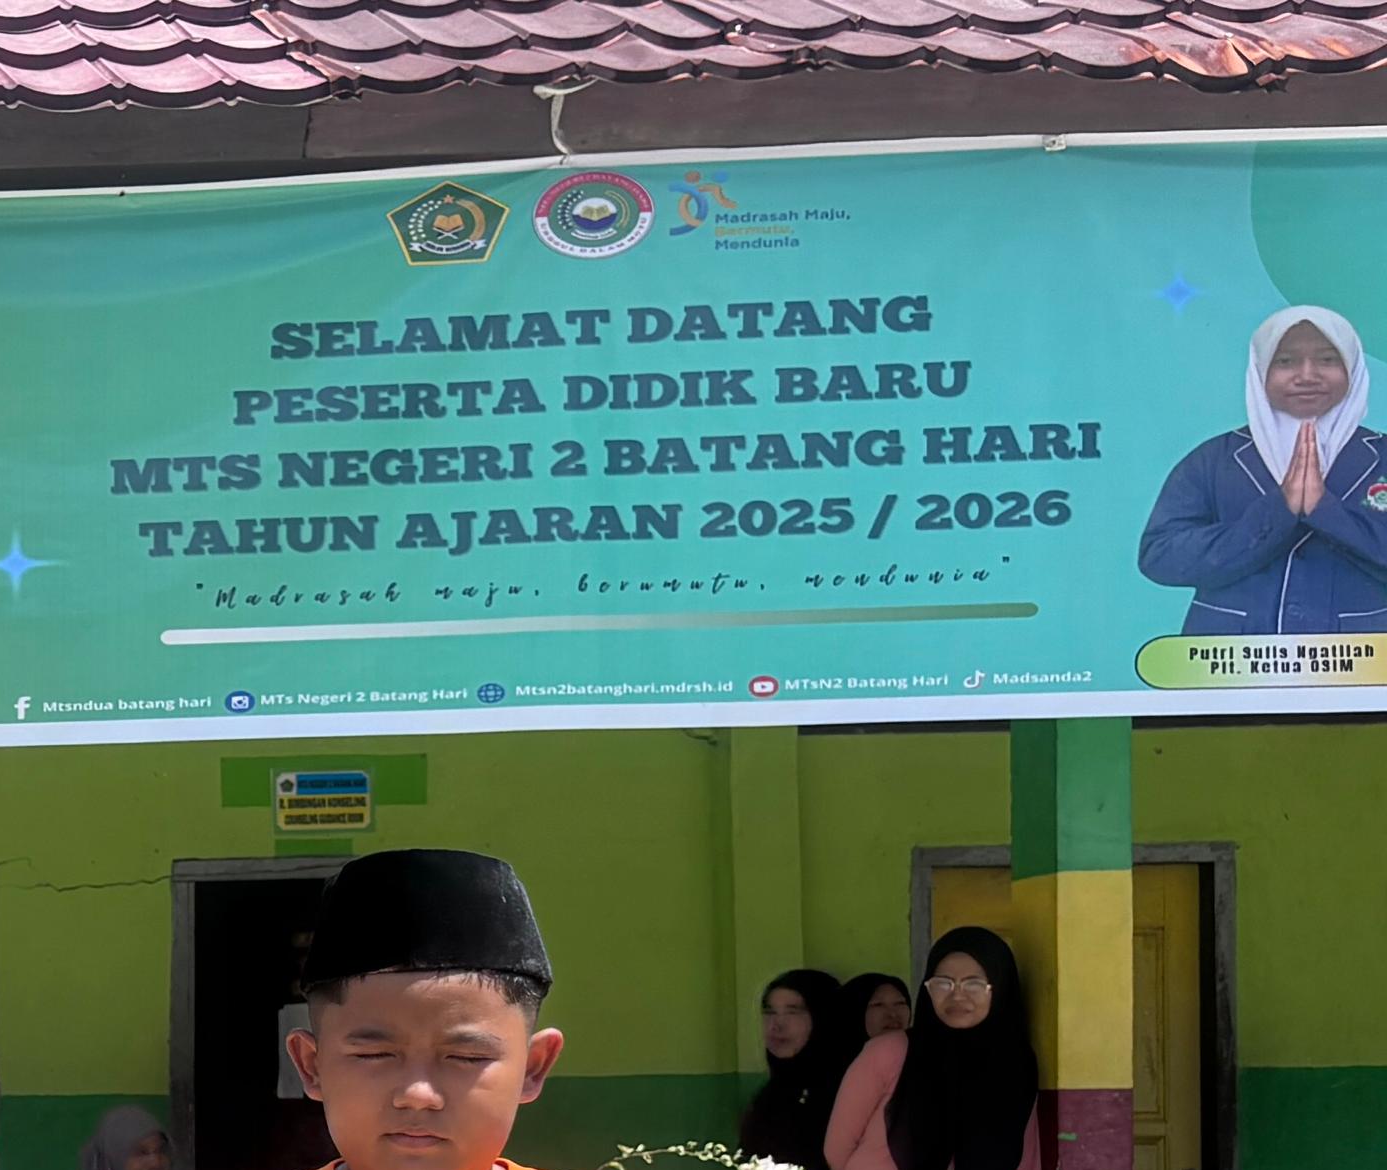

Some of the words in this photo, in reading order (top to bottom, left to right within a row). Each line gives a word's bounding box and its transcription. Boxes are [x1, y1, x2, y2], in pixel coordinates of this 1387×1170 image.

[715, 210, 799, 224] Madrasah
[804, 208, 851, 221] Maju,
[714, 236, 800, 250] Mendunia
[270, 308, 610, 360] SELAMAT
[627, 295, 933, 343] DATANG
[233, 378, 546, 426] PESERTA
[563, 369, 757, 412] DIDIK
[774, 360, 972, 404] BARU
[110, 453, 262, 495] MTS
[277, 442, 534, 488] NEGERI
[550, 439, 589, 478] 2
[603, 429, 905, 477] BATANG
[922, 422, 1102, 465] HARI
[138, 515, 379, 557] TAHUN
[395, 503, 683, 556] AJARAN
[699, 497, 855, 539] 2025
[866, 494, 899, 540] /
[914, 489, 1073, 531] 2026
[434, 581, 539, 607] maju,
[1189, 646, 1234, 660] Putri
[1242, 645, 1288, 659] Sulis
[1210, 660, 1242, 674] Plt.
[1250, 659, 1302, 674] Ketua
[1310, 658, 1354, 673] OSIM
[784, 678, 842, 691] MTsN2
[847, 676, 907, 692] Batang
[913, 673, 949, 688] Hari
[993, 670, 1093, 685] Madsanda2
[259, 693, 294, 706] MTs
[297, 690, 351, 707] Negeri
[354, 690, 366, 703] 2
[369, 688, 428, 705] Batang
[432, 687, 468, 701] Hari
[515, 680, 733, 698] Mtsn2batanghari.mdrsh.id
[42, 698, 114, 713] Mtsndua
[117, 696, 174, 713] batang
[178, 695, 212, 709] hari
